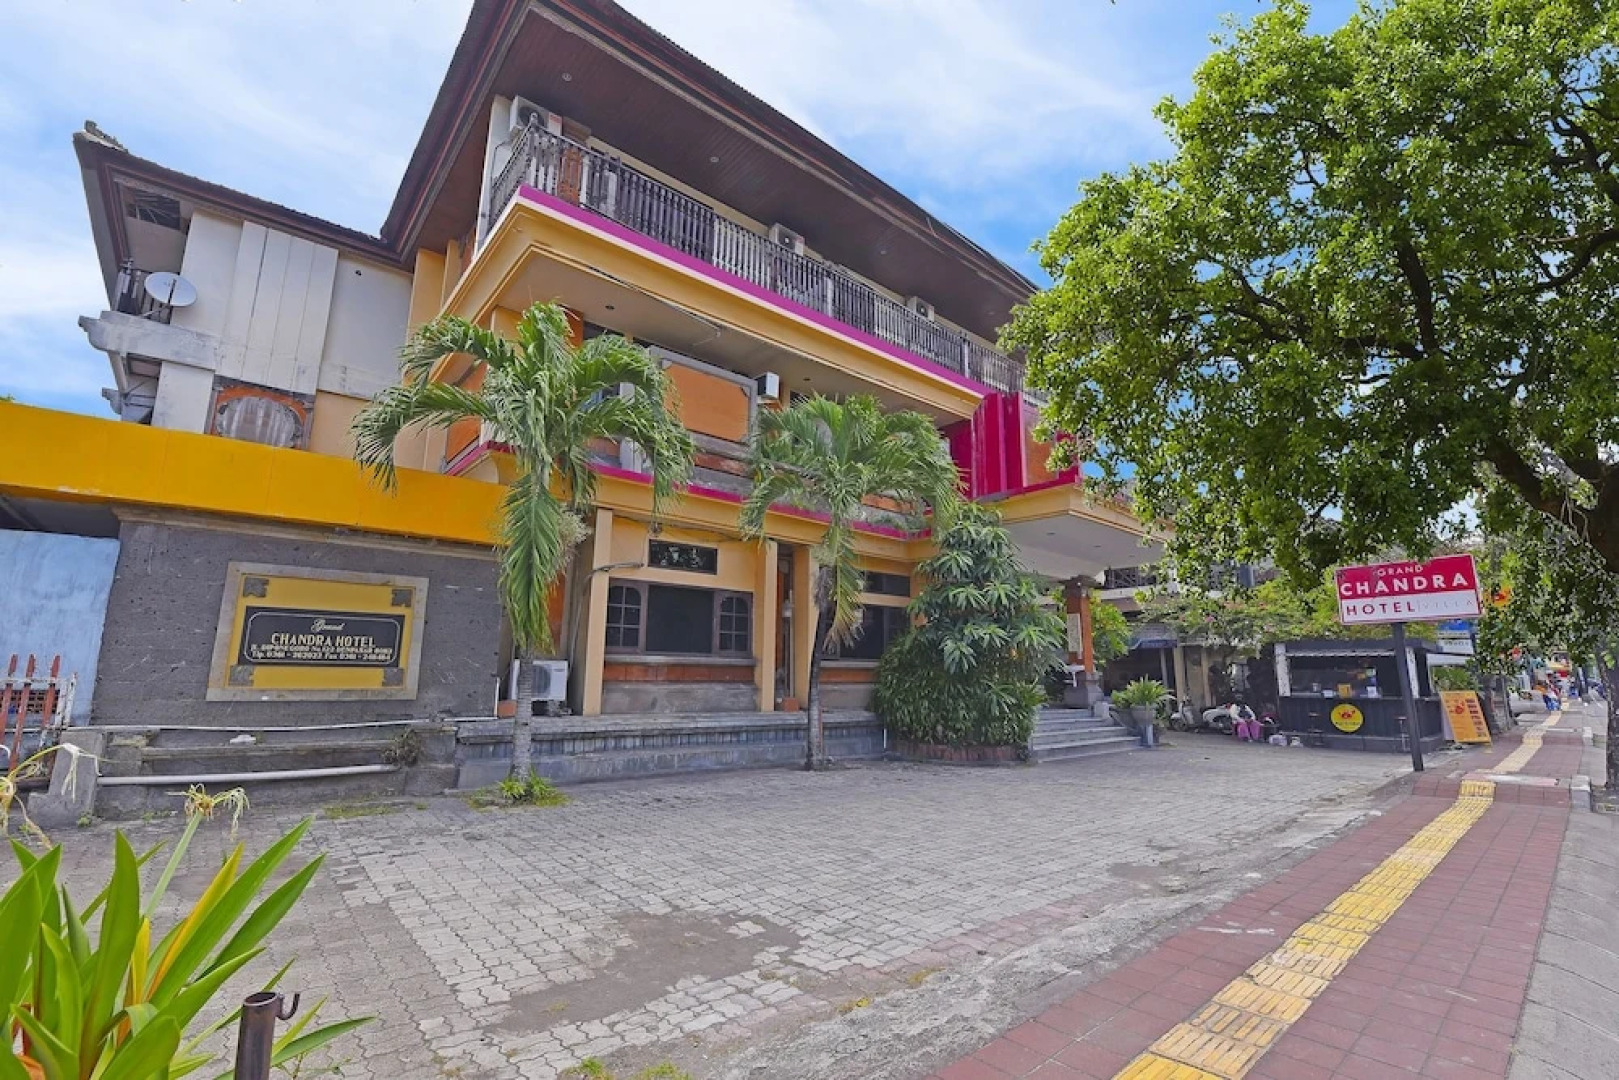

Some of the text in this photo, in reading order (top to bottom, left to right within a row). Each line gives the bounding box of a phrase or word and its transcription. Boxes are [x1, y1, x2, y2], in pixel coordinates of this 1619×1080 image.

[1377, 565, 1424, 576] GRAND
[1340, 573, 1468, 596] CHANDRA
[1346, 601, 1416, 616] HOTEL
[311, 619, 345, 632] Grand
[271, 633, 375, 648] CHANDRA HOTEL
